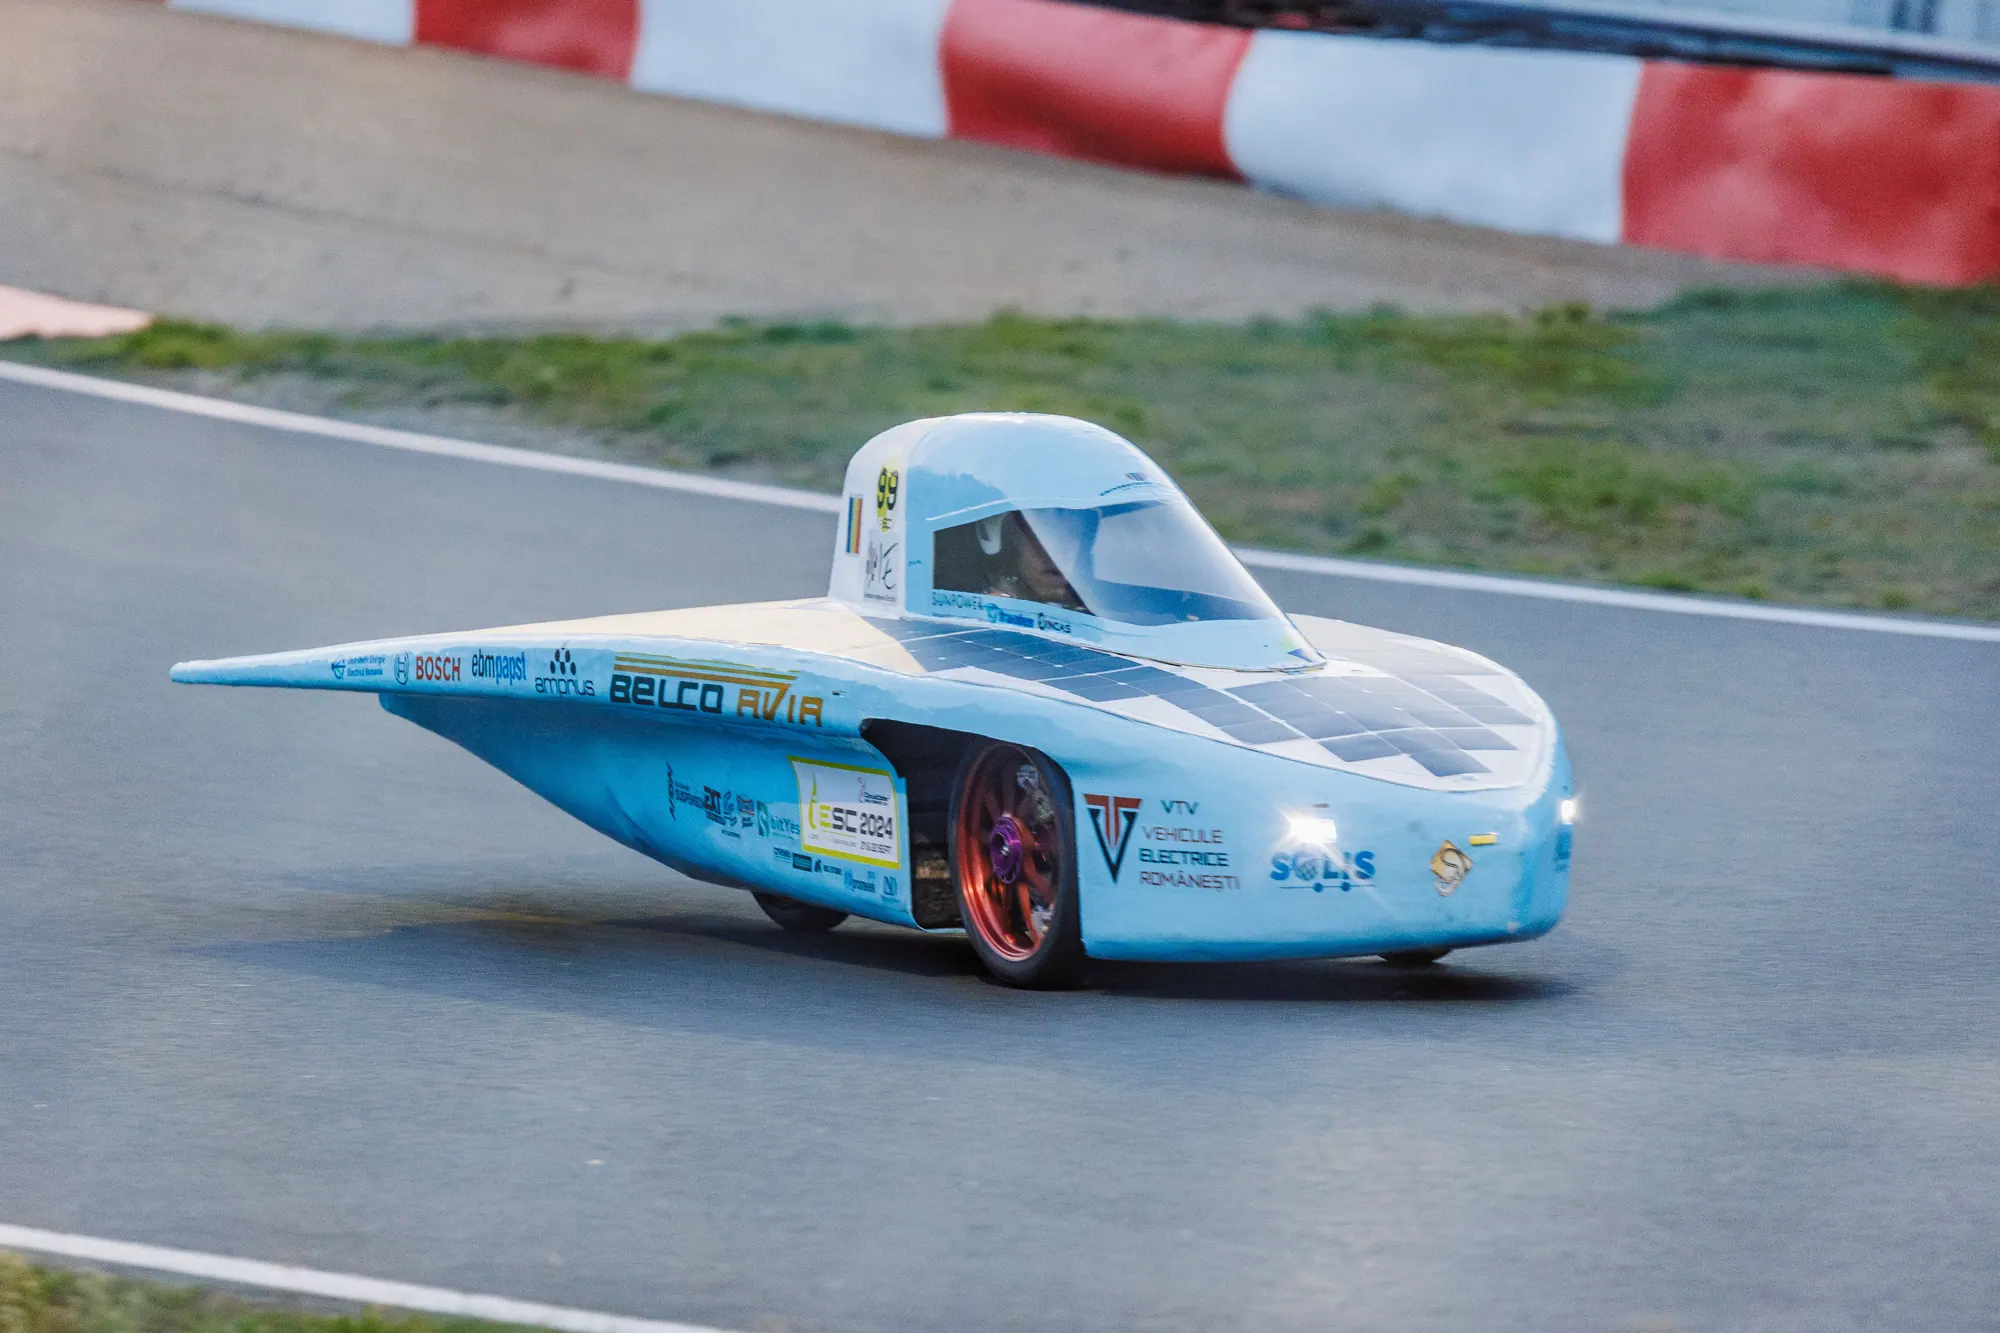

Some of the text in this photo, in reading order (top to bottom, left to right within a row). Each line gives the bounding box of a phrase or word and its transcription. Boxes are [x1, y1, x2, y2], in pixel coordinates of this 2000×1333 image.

[877, 466, 898, 510] 99
[416, 655, 461, 681] BOSCH
[471, 649, 527, 686] ebmpapst
[736, 683, 824, 728] AVIA
[1160, 800, 1199, 815] VTV
[860, 811, 894, 840] 2024
[1142, 826, 1224, 844] VEHICULE
[1138, 847, 1229, 867] ELECTRICE
